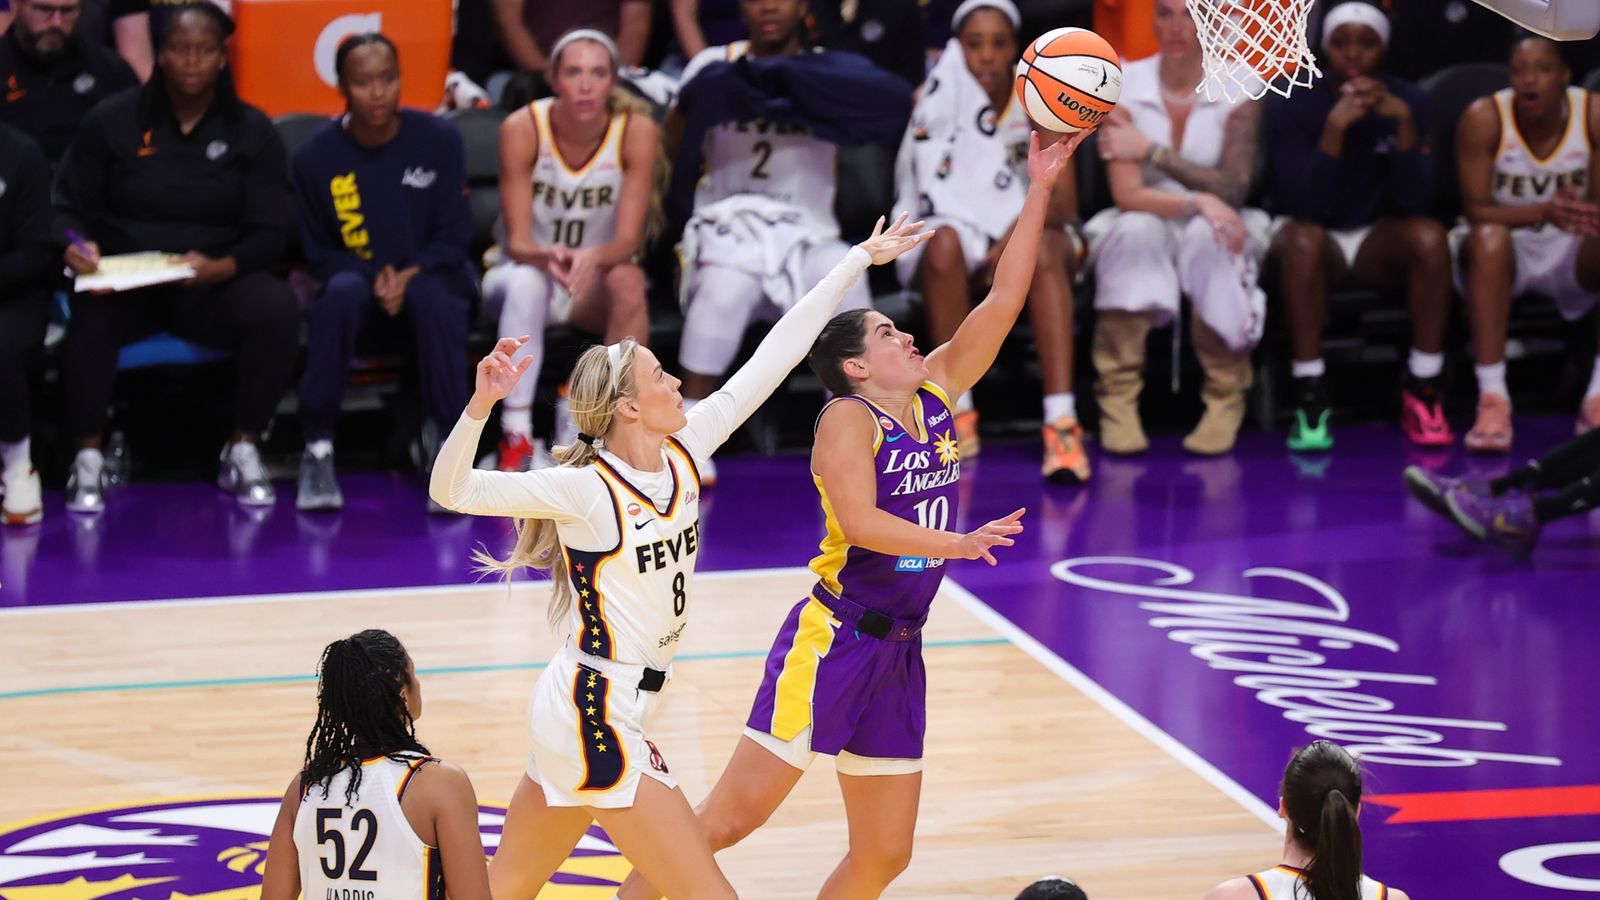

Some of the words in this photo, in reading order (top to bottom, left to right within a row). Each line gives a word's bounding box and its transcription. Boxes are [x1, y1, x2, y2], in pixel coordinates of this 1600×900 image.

[751, 140, 772, 179] 2
[532, 181, 613, 210] FEVER
[552, 219, 584, 249] 10
[928, 409, 949, 427] Albert
[913, 496, 949, 532] 10
[899, 559, 923, 568] UCLA
[672, 571, 686, 617] 8
[1050, 555, 1562, 767] Michelob
[316, 808, 379, 882] 52
